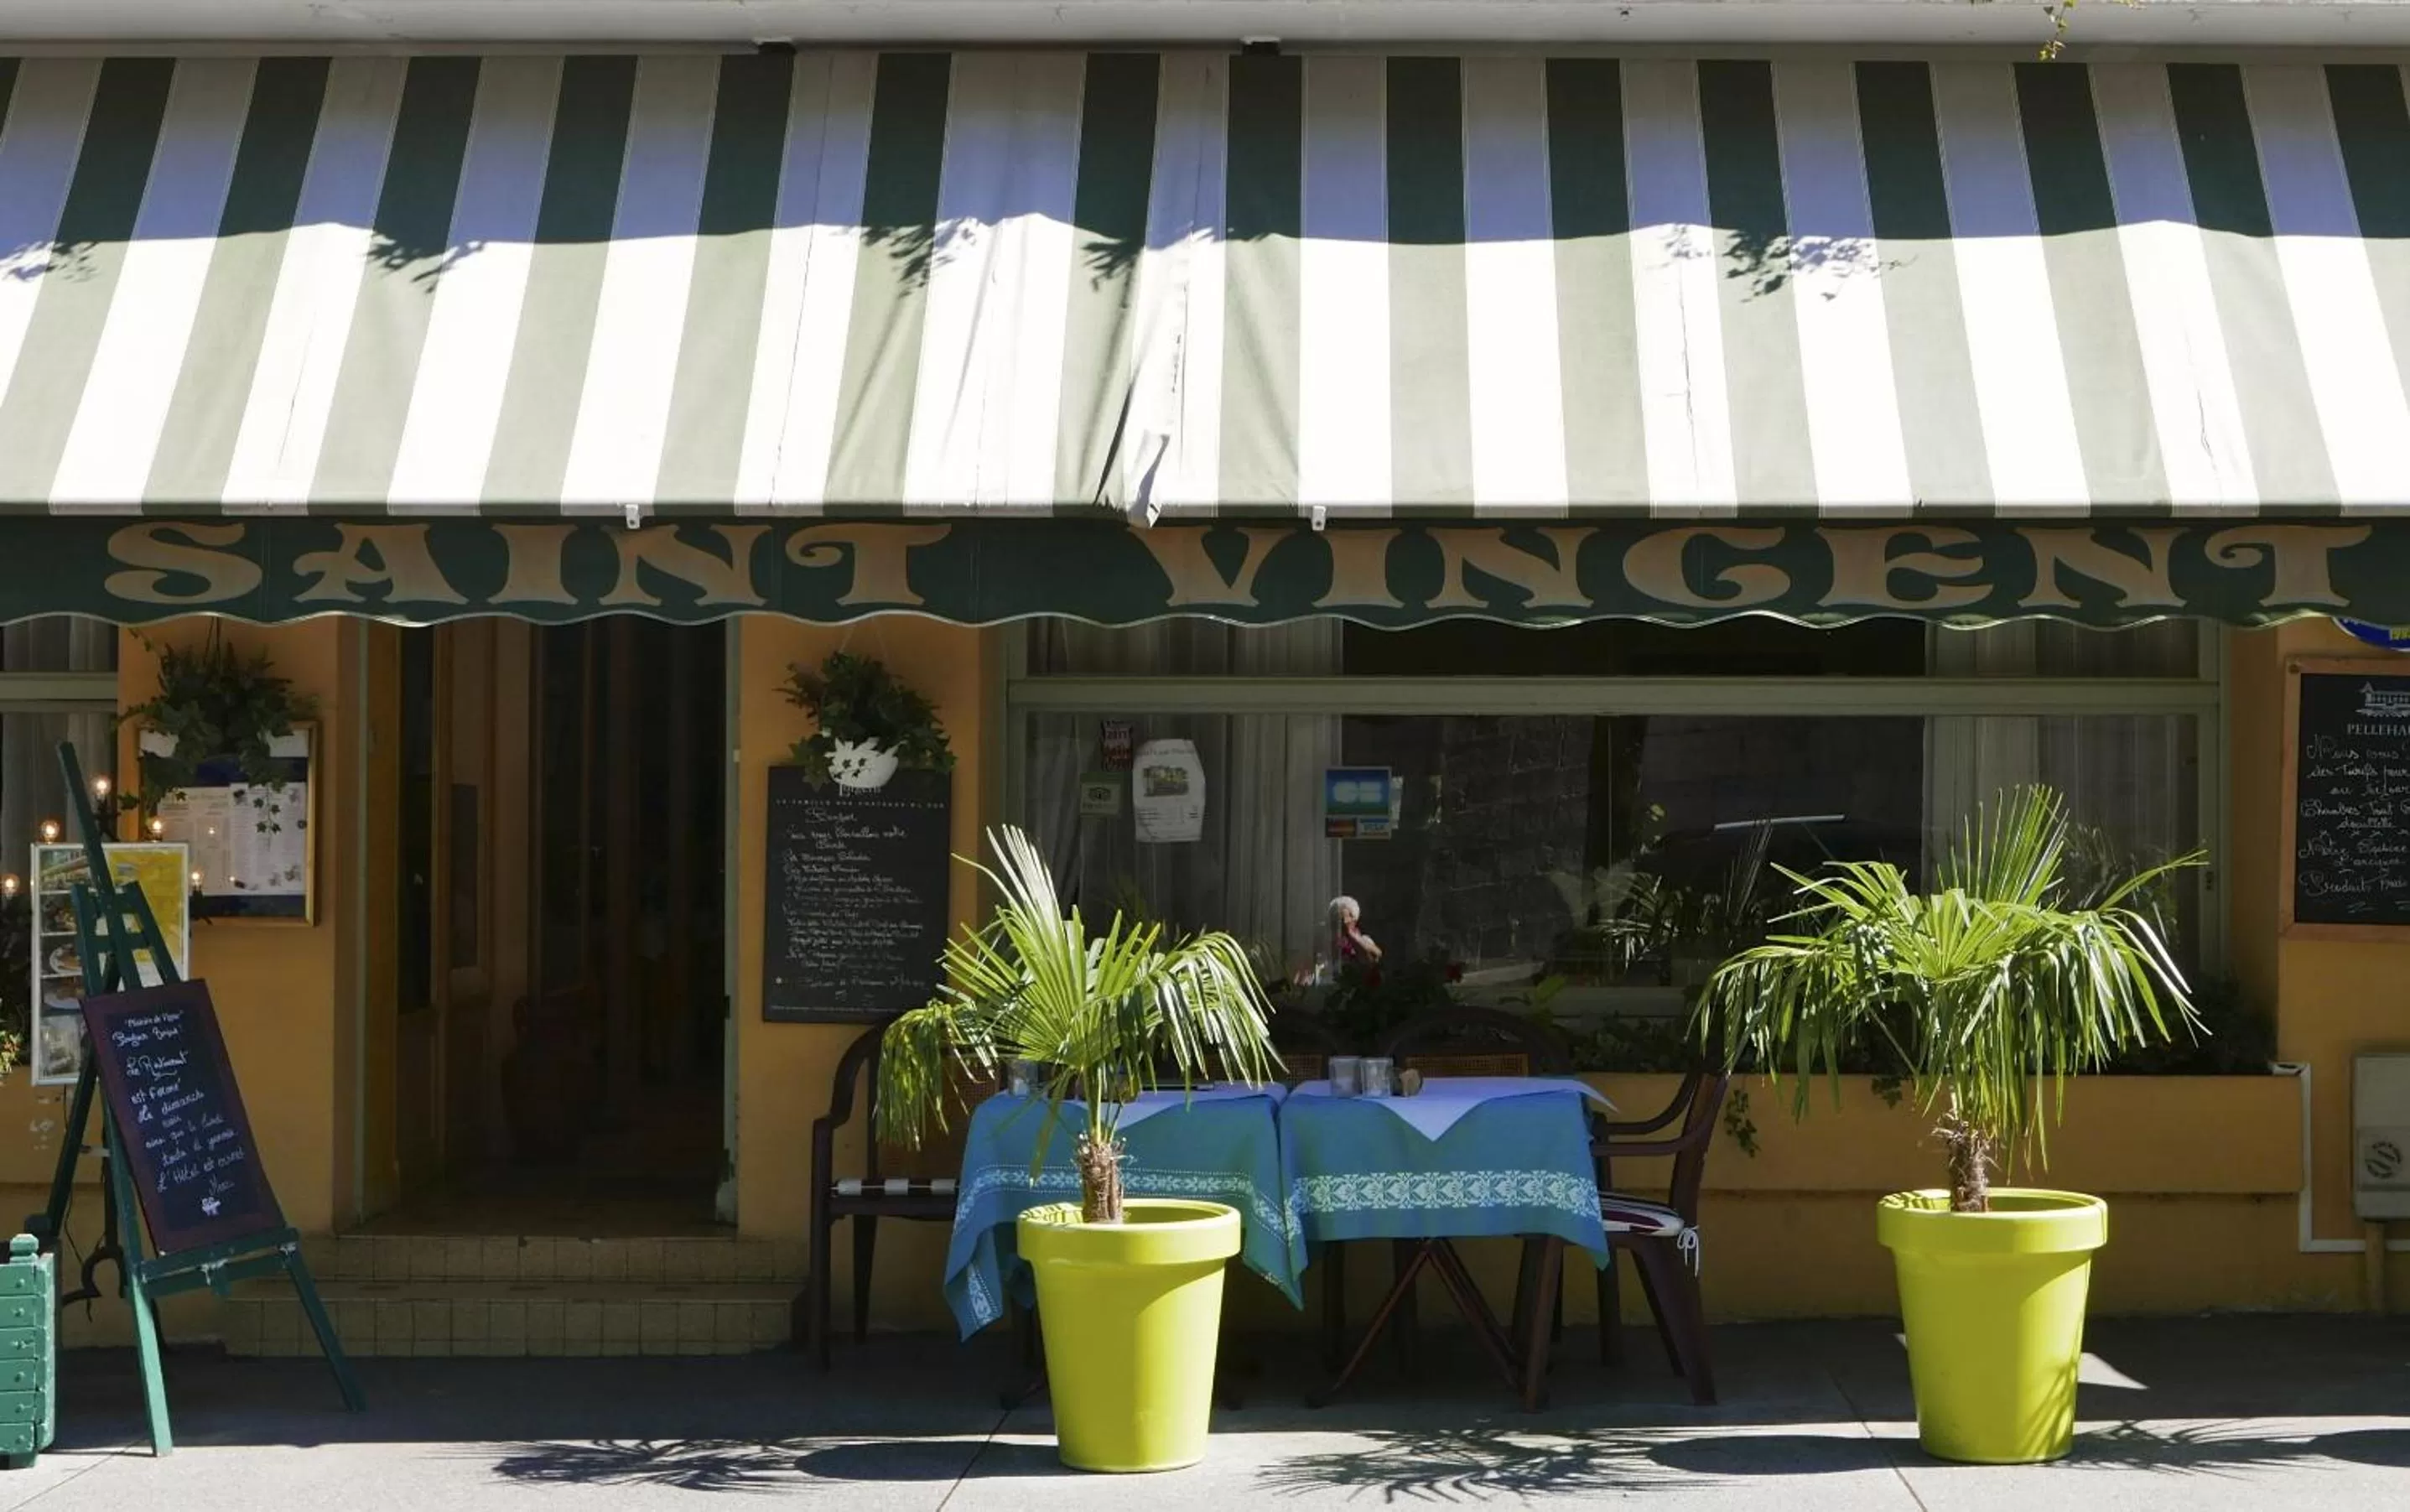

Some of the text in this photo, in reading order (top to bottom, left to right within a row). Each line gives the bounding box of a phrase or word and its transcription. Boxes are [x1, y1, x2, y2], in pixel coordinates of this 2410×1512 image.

[104, 522, 2372, 609] SAINT VINCENT
[2347, 723, 2410, 735] PELLEHA
[162, 1089, 205, 1115] dimanche
